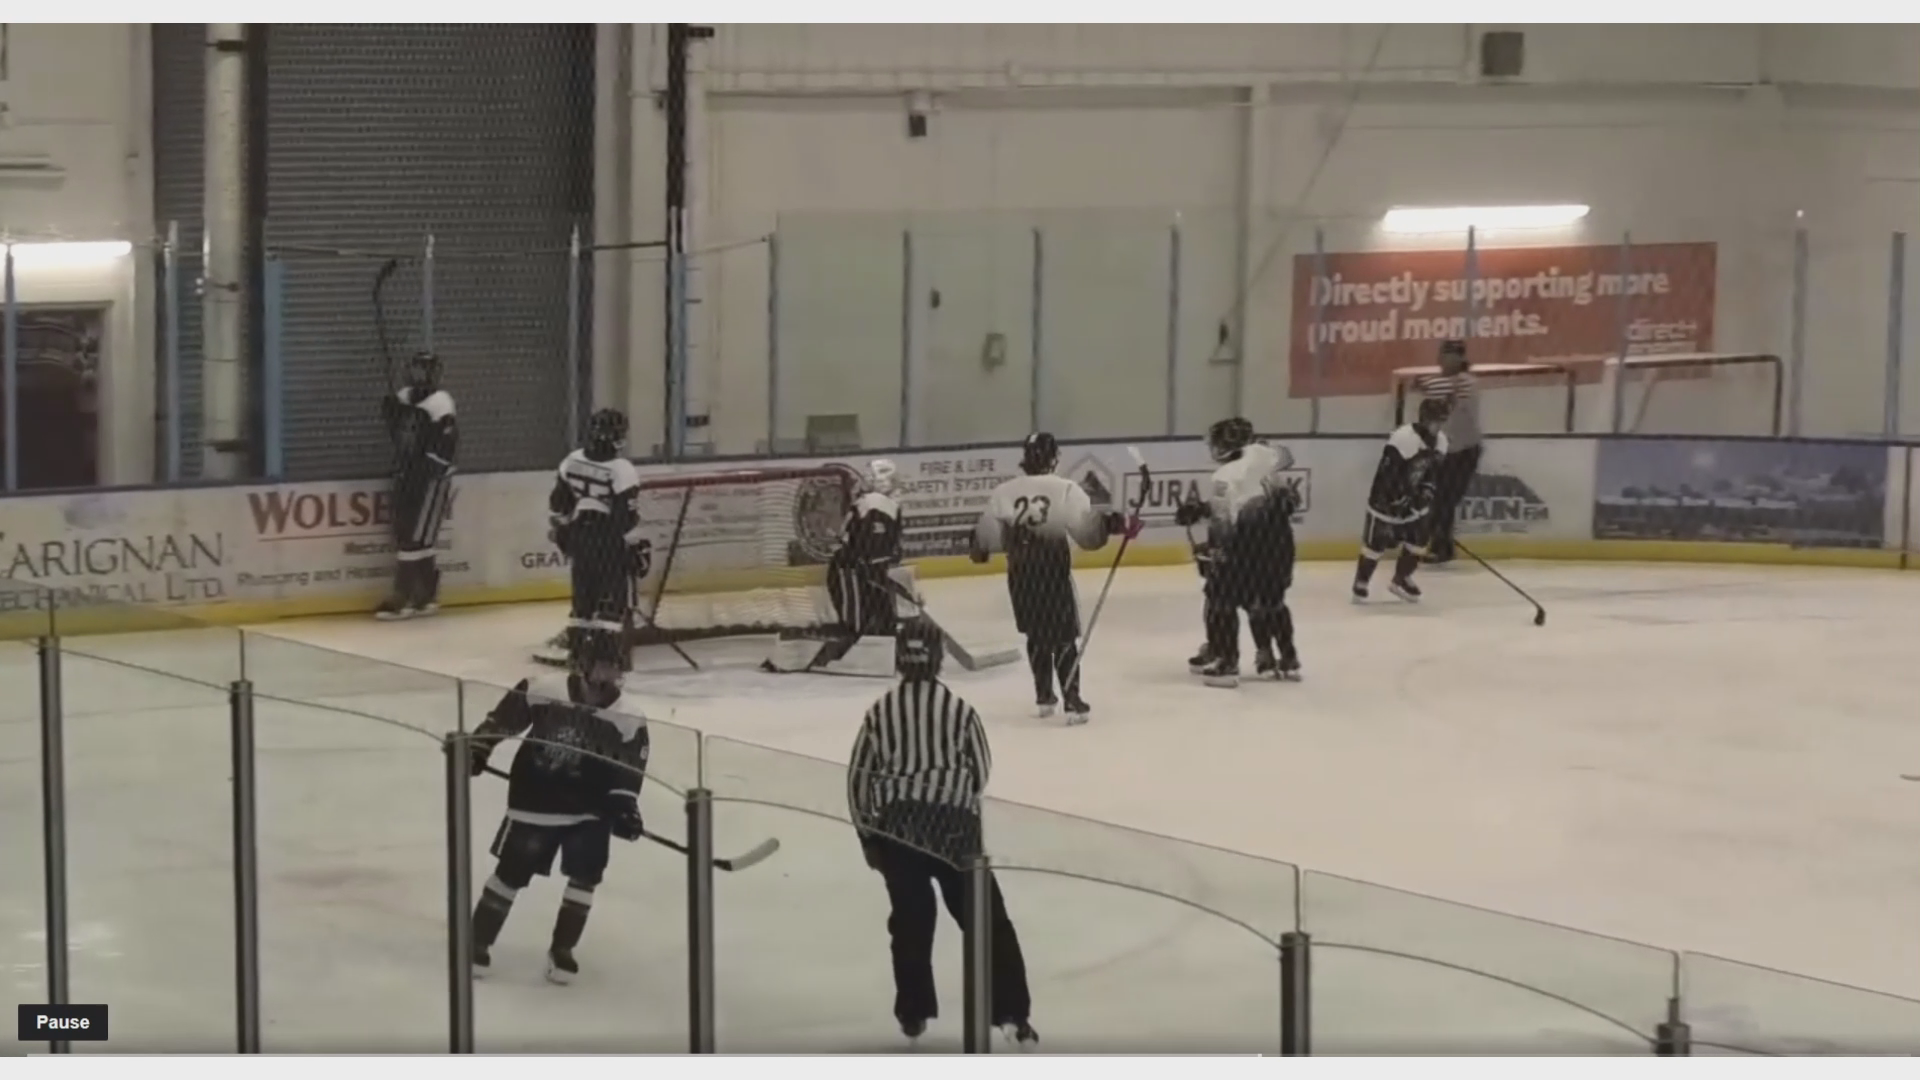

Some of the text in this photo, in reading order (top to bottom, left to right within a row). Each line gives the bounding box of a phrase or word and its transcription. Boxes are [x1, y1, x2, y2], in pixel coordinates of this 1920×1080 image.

[1310, 266, 1672, 312] Directly supporting more
[1307, 309, 1399, 353] proud
[919, 461, 952, 475] FIRE
[967, 458, 996, 473] LIFE
[900, 479, 949, 494] SAFETY
[1013, 494, 1051, 528] 23
[1459, 498, 1522, 521] TAIN
[0, 532, 223, 579] ARIGNAN
[0, 582, 159, 612] ECHANICAL
